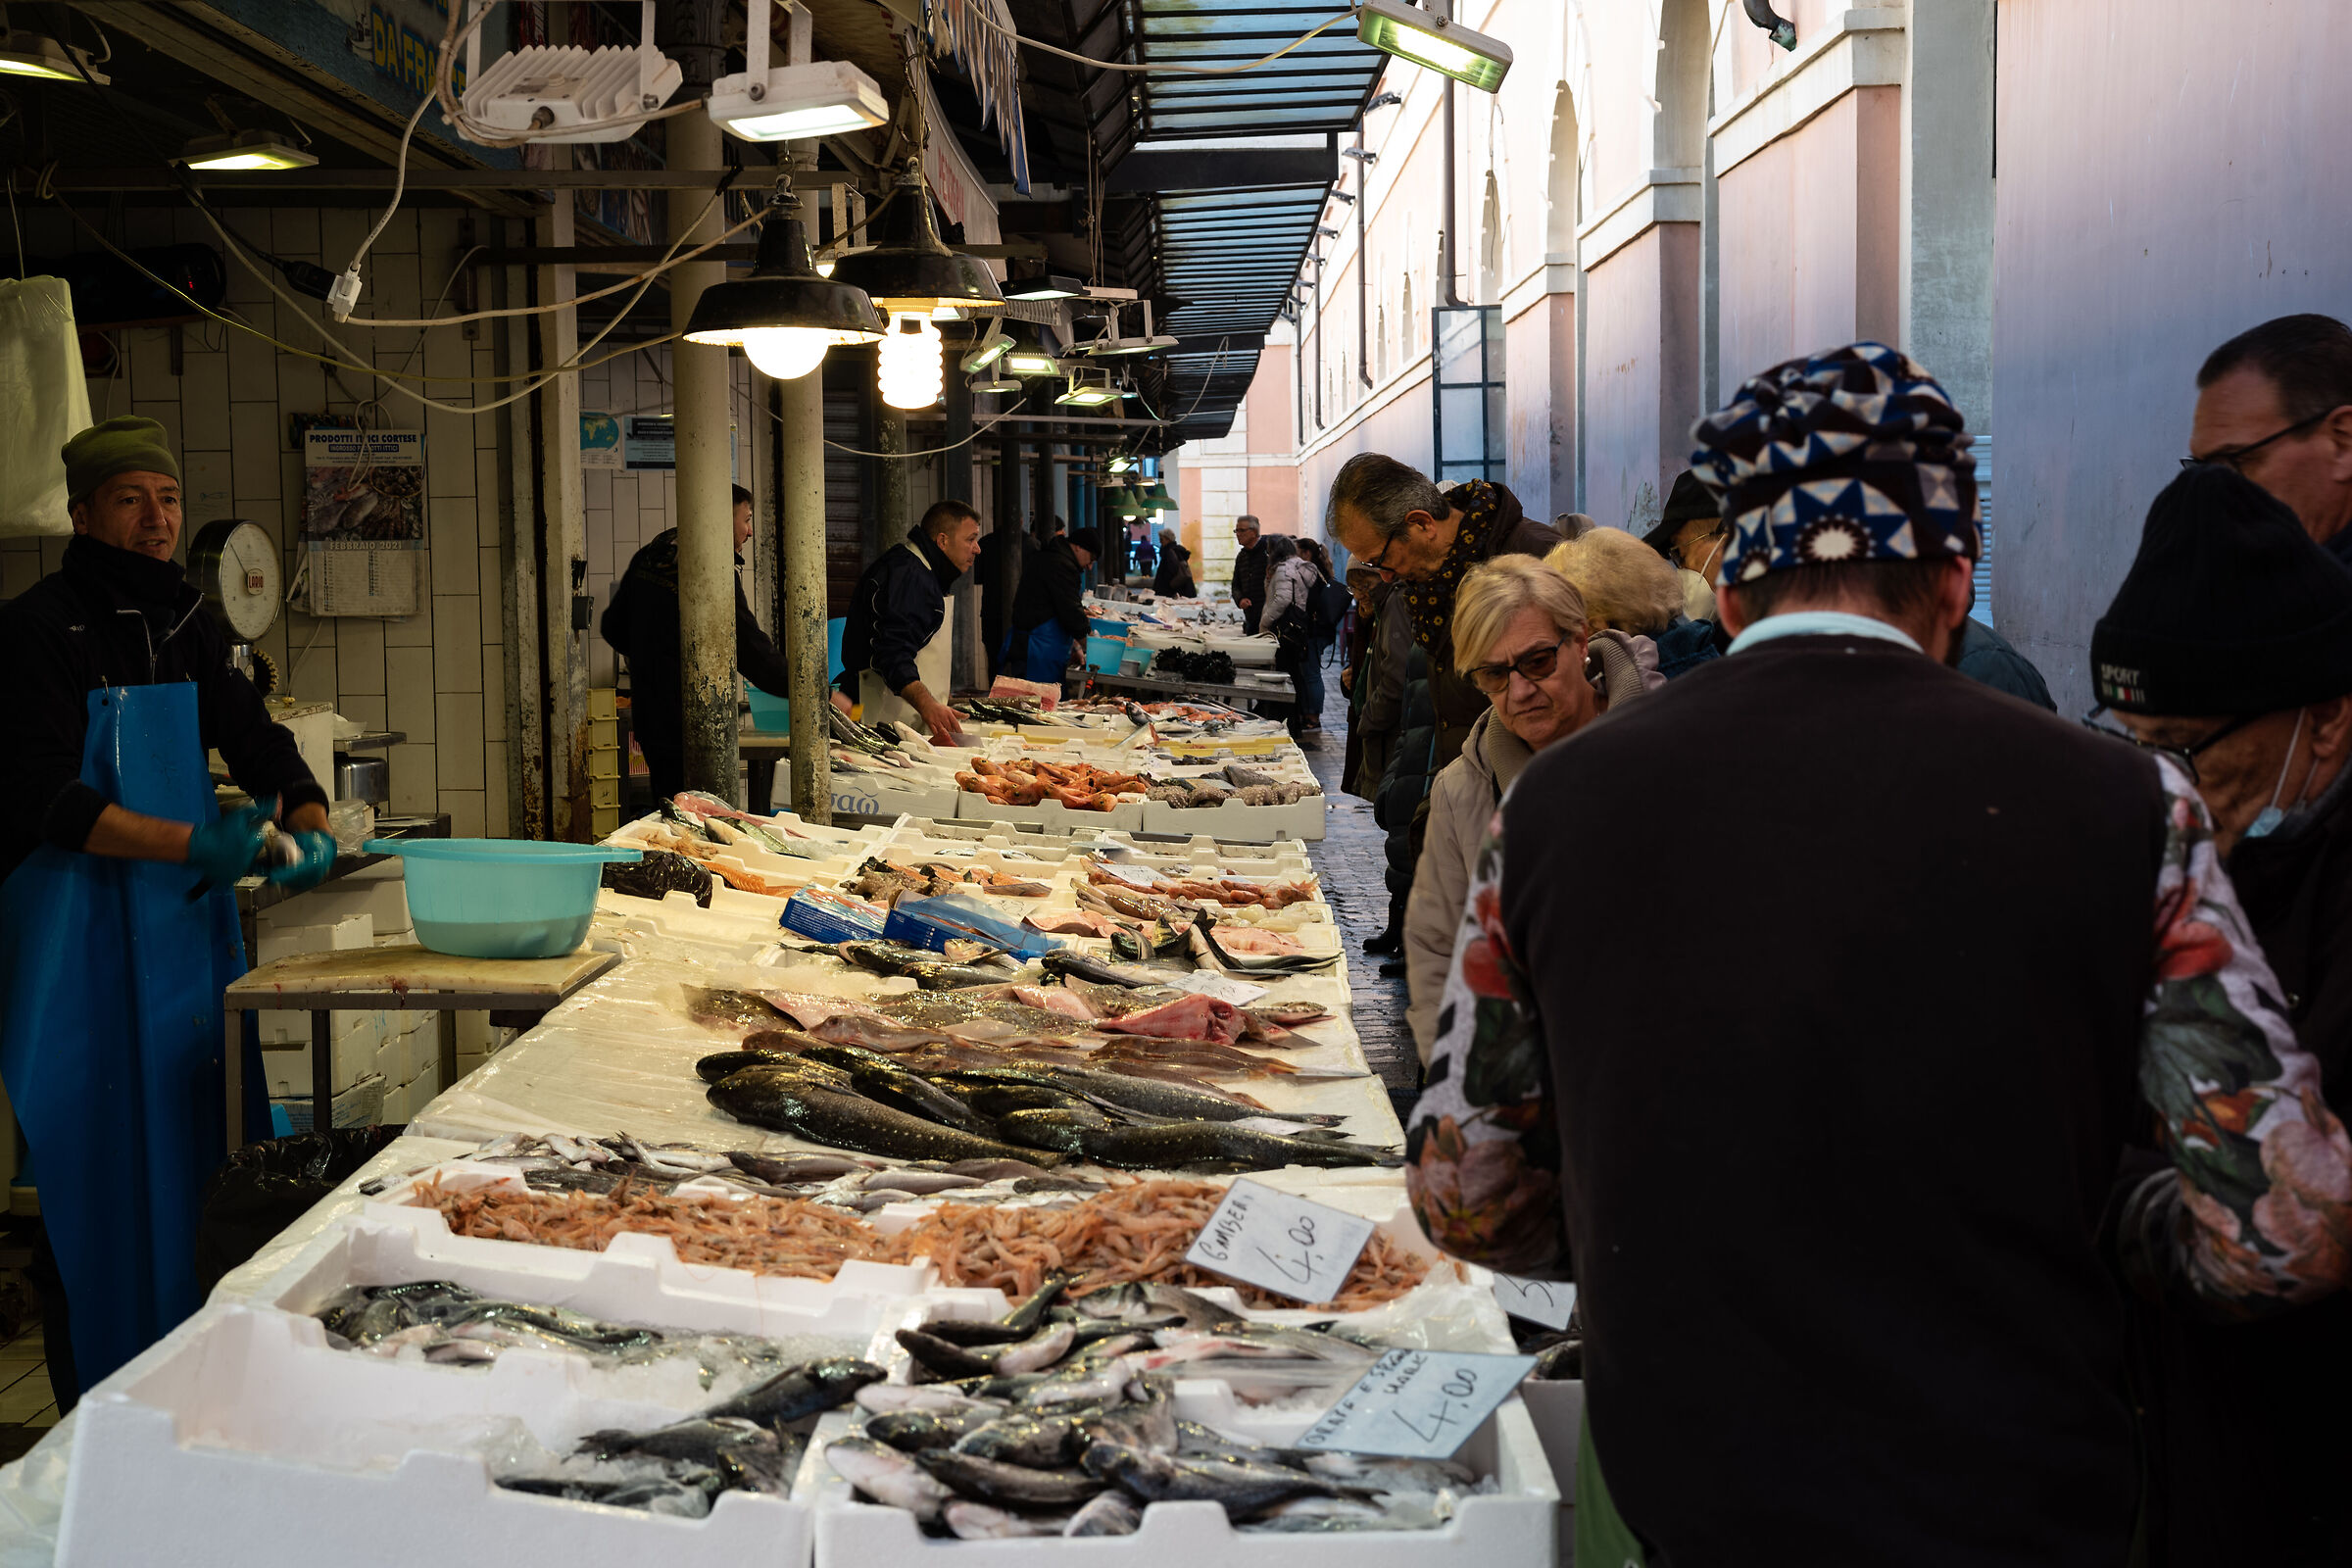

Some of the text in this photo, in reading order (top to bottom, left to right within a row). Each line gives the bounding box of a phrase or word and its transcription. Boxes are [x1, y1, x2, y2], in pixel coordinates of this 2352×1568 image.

[372, 12, 400, 78] DA
[310, 434, 353, 443] PRODOTTI
[382, 434, 416, 443] CORTESE
[379, 541, 402, 550] 2021
[2100, 662, 2140, 687] SPORT
